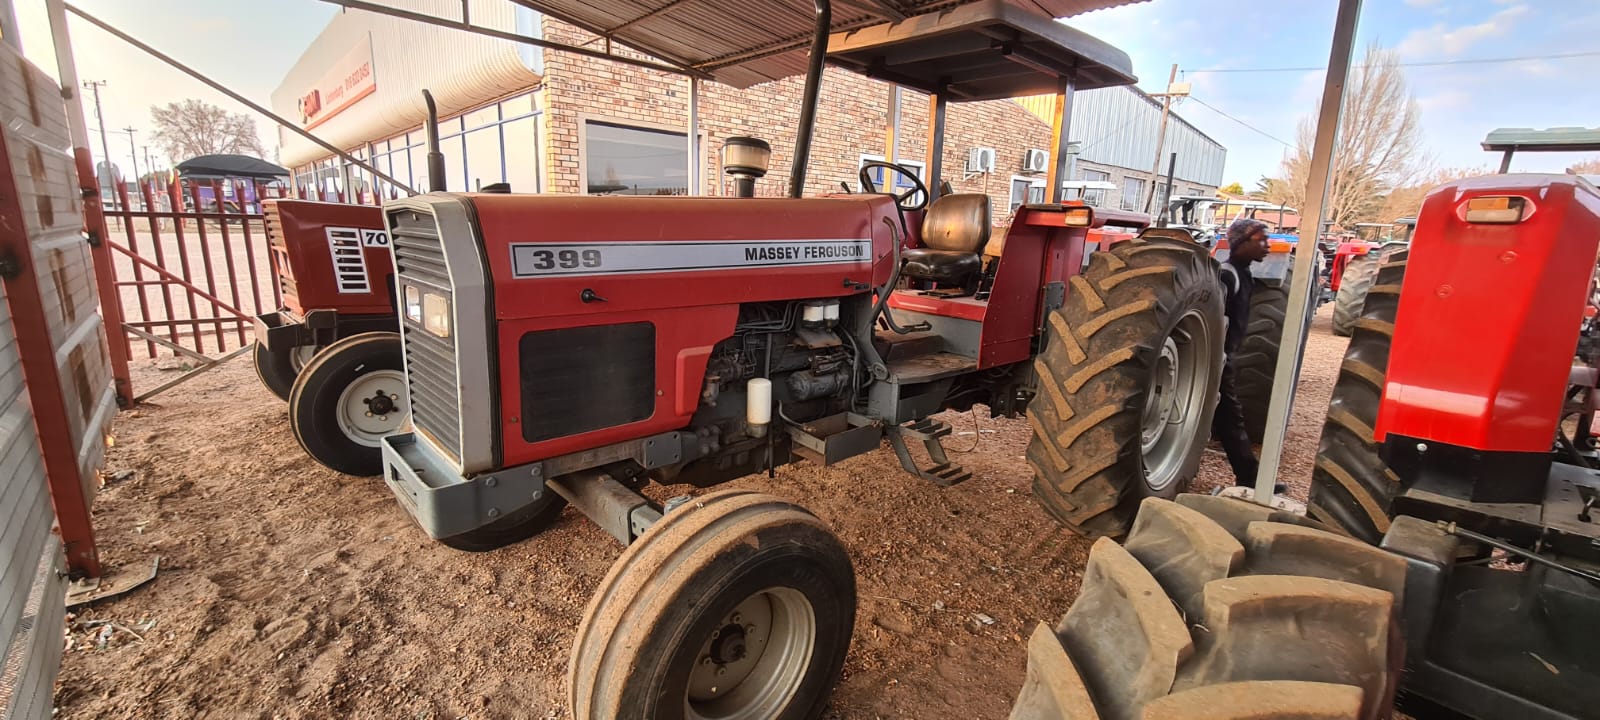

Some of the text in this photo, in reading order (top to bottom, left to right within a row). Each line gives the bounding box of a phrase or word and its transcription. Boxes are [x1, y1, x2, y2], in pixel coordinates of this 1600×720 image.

[365, 231, 388, 245] 70
[533, 249, 602, 270] 399
[745, 245, 864, 261] MASSEY FERGUSON
